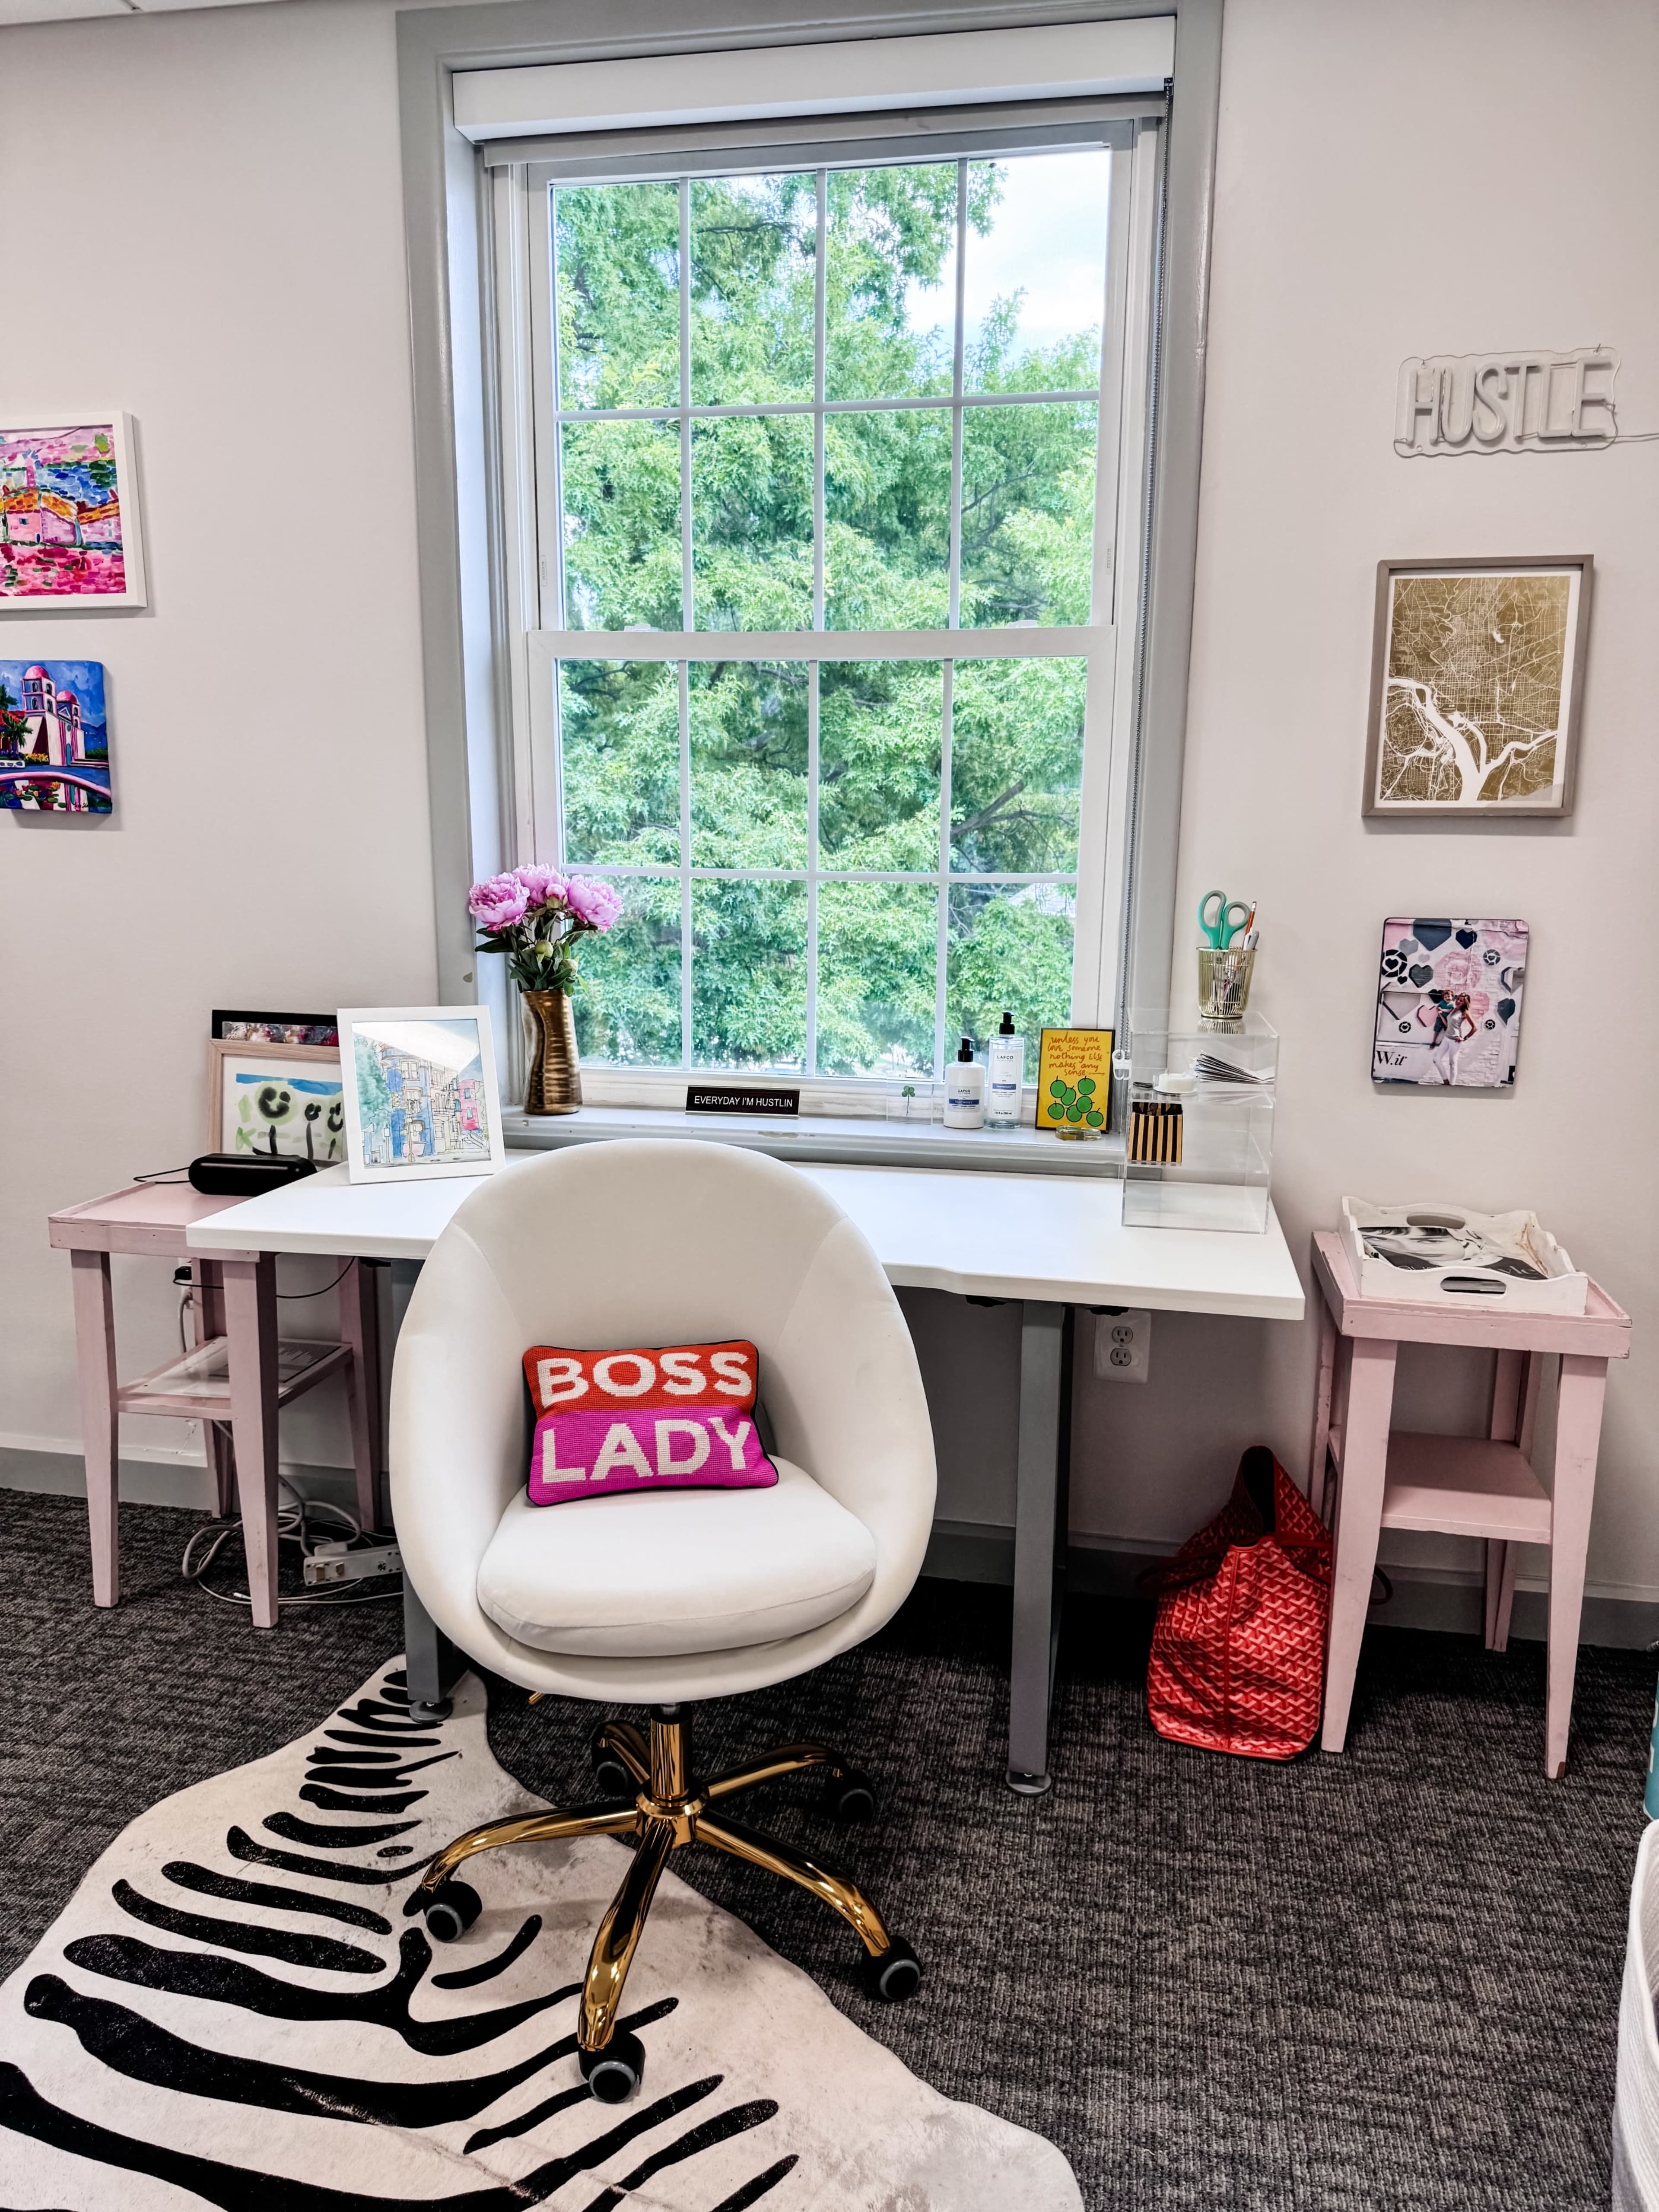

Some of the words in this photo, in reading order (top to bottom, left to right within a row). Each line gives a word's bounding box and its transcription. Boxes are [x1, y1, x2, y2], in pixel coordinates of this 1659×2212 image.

[1406, 356, 1611, 446] HUSTLE
[1051, 1031, 1079, 1044] unless
[1084, 1036, 1100, 1046] you
[1048, 1042, 1063, 1052] love
[1050, 1052, 1085, 1063] nothing
[1049, 1060, 1076, 1070] makes
[1081, 1063, 1099, 1072] any
[694, 1095, 741, 1105] EVERYDAY
[742, 1097, 754, 1106] I'M
[756, 1098, 793, 1108] HUSTLIN
[537, 1352, 752, 1408] BOSS
[542, 1417, 751, 1483] LADY
